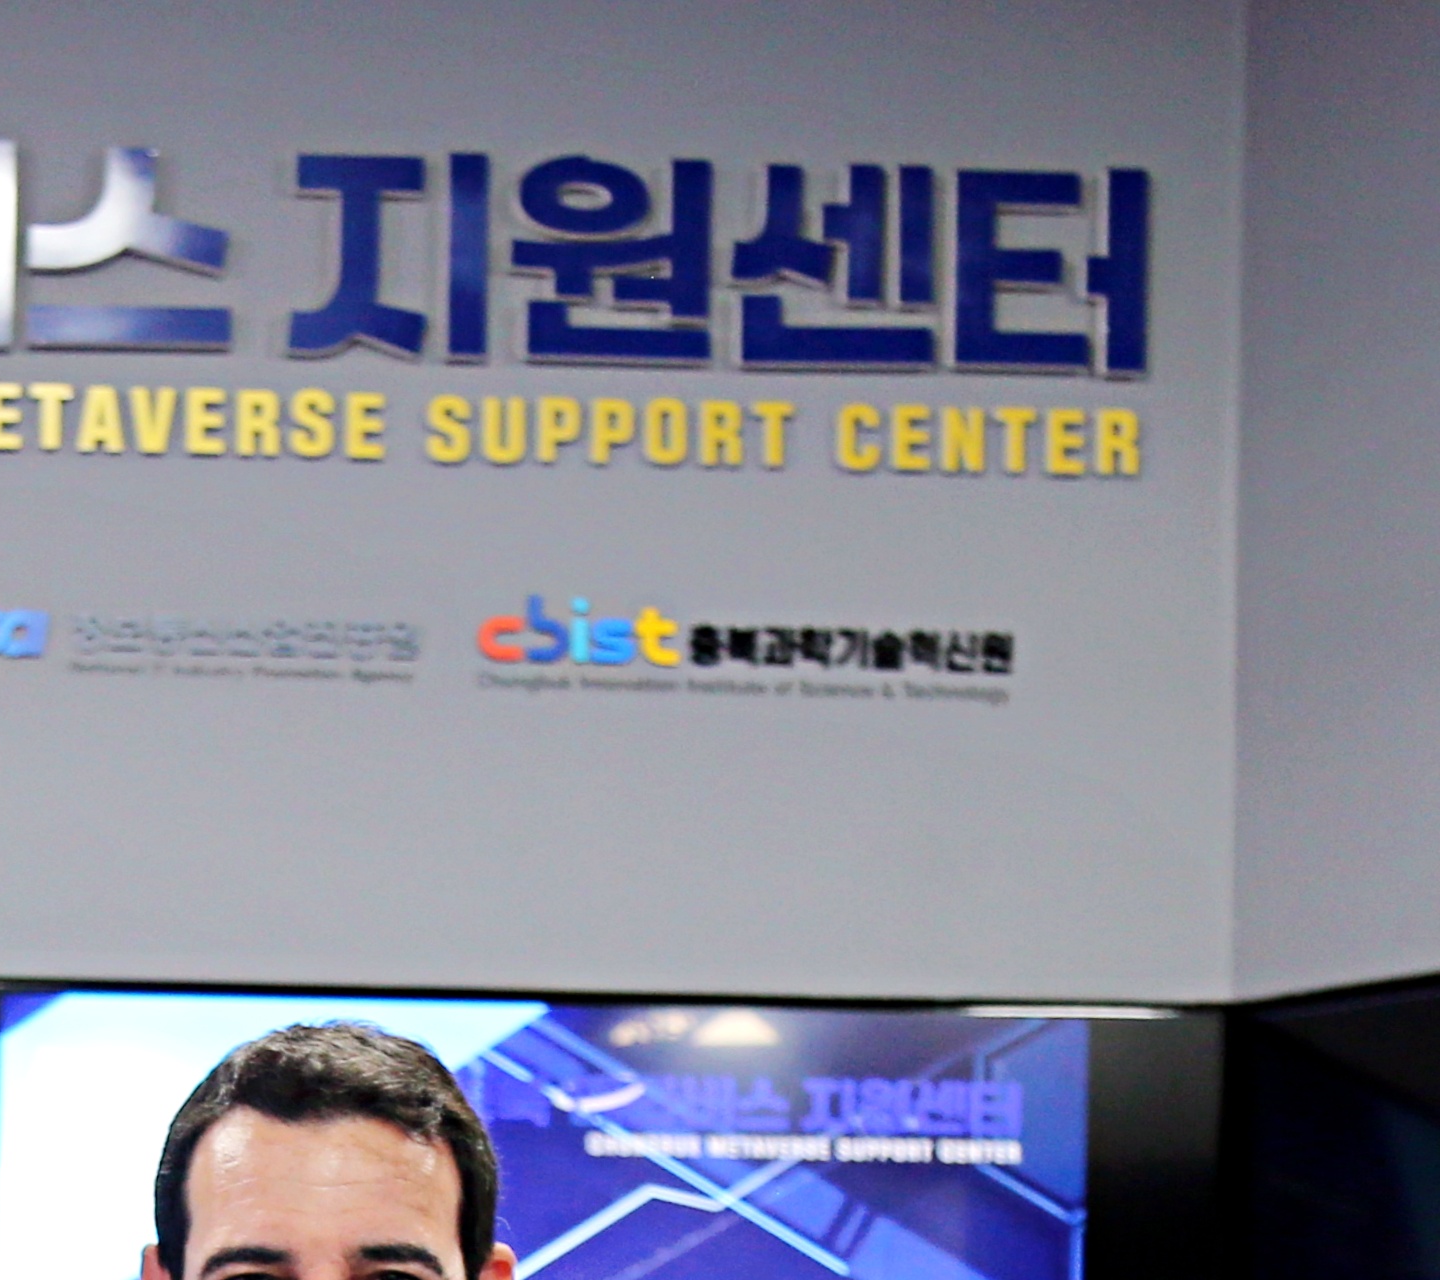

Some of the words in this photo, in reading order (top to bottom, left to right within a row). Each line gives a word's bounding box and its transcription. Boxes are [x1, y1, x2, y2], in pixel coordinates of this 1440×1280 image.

[286, 150, 1150, 378] 지원센터
[426, 393, 796, 470] SUPPORT
[837, 402, 1142, 478] CENTER
[477, 594, 682, 667] cbist
[689, 624, 1015, 675] 충북과학기술혁신원
